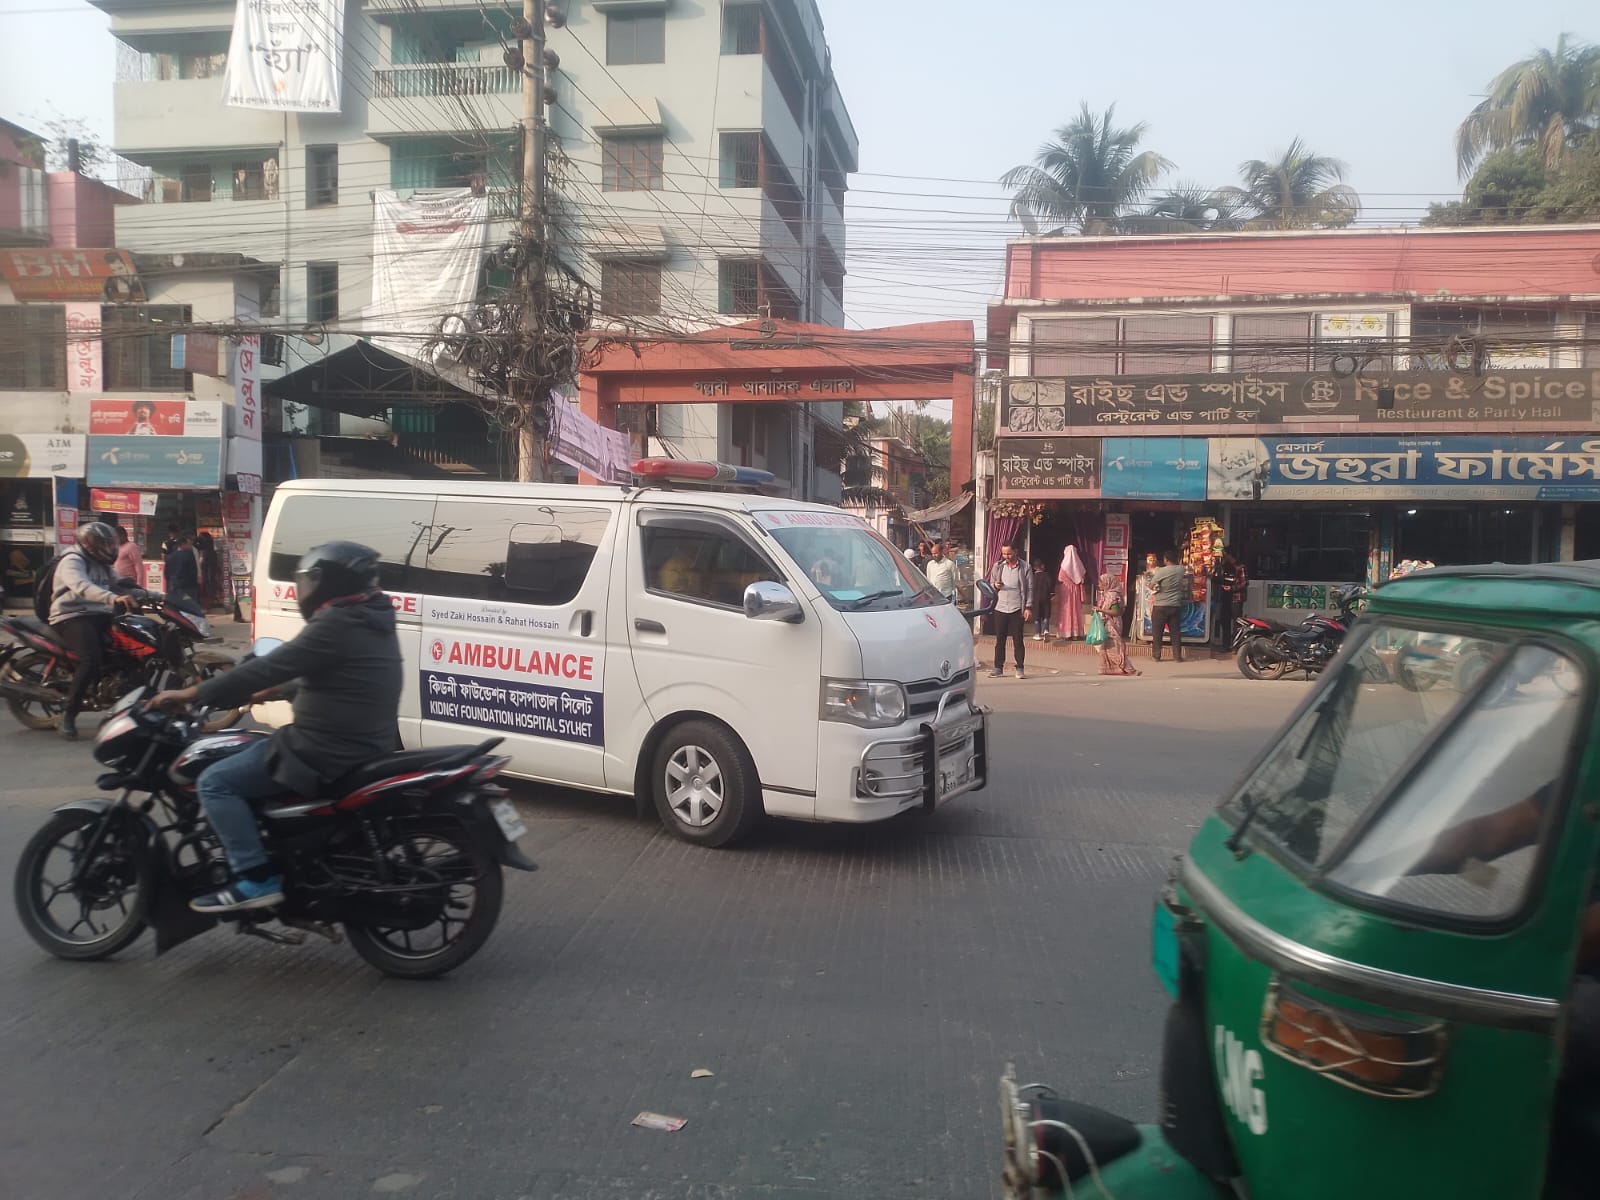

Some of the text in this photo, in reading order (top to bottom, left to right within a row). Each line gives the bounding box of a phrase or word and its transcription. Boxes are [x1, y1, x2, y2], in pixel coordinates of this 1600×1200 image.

[10, 252, 93, 277] BM
[693, 377, 857, 397] পল্লবী আবাসিক এলাকা
[1070, 374, 1288, 408] রাইছ এন্ড স্পাইস
[1444, 376, 1471, 399] &
[1483, 375, 1586, 405] Spice
[1097, 408, 1161, 425] রেস্টুরেন্ট
[1200, 407, 1232, 421] পার্টি
[1377, 406, 1561, 420] Restaurant & Party Hall
[47, 439, 71, 448] ATM
[1275, 440, 1325, 452] মেসার্স
[1001, 454, 1031, 473] রাইছ
[1056, 452, 1095, 473] স্পাইস
[1275, 449, 1423, 483] জহুরা
[431, 609, 560, 629] Syed Zaki Hossain & Rahat Hossain
[448, 641, 594, 681] AMBULANCE
[428, 674, 594, 716] কিডনী ফাউন্ডেশন হাসপাতাল সিলেট
[429, 700, 593, 738] KIDNEY FOUNDATION HOSPITAL SYLHET
